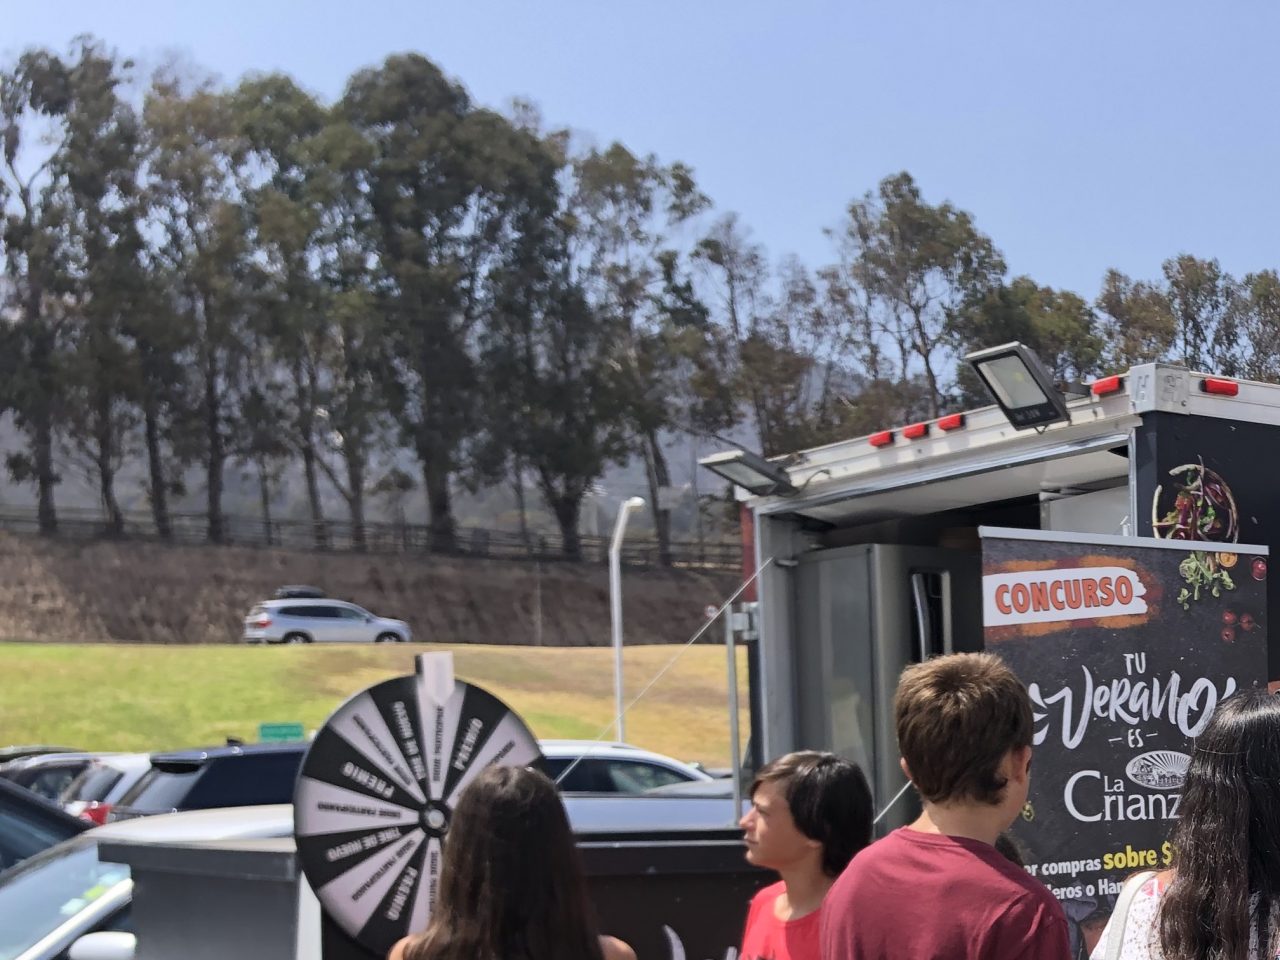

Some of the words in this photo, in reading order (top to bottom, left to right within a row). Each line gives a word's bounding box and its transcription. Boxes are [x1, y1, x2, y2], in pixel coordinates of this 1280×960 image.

[995, 575, 1133, 615] CONCURSO
[1123, 652, 1146, 675] TU
[454, 718, 483, 770] PREMIO
[1127, 729, 1144, 748] ES
[342, 761, 394, 798] PREMIO
[1064, 770, 1184, 822] Crianz
[1104, 776, 1124, 793] La
[1024, 864, 1038, 877] or
[1041, 858, 1101, 878] compras
[1103, 845, 1158, 870] sobre
[385, 866, 418, 920] PREMIO
[1085, 886, 1096, 897] o
